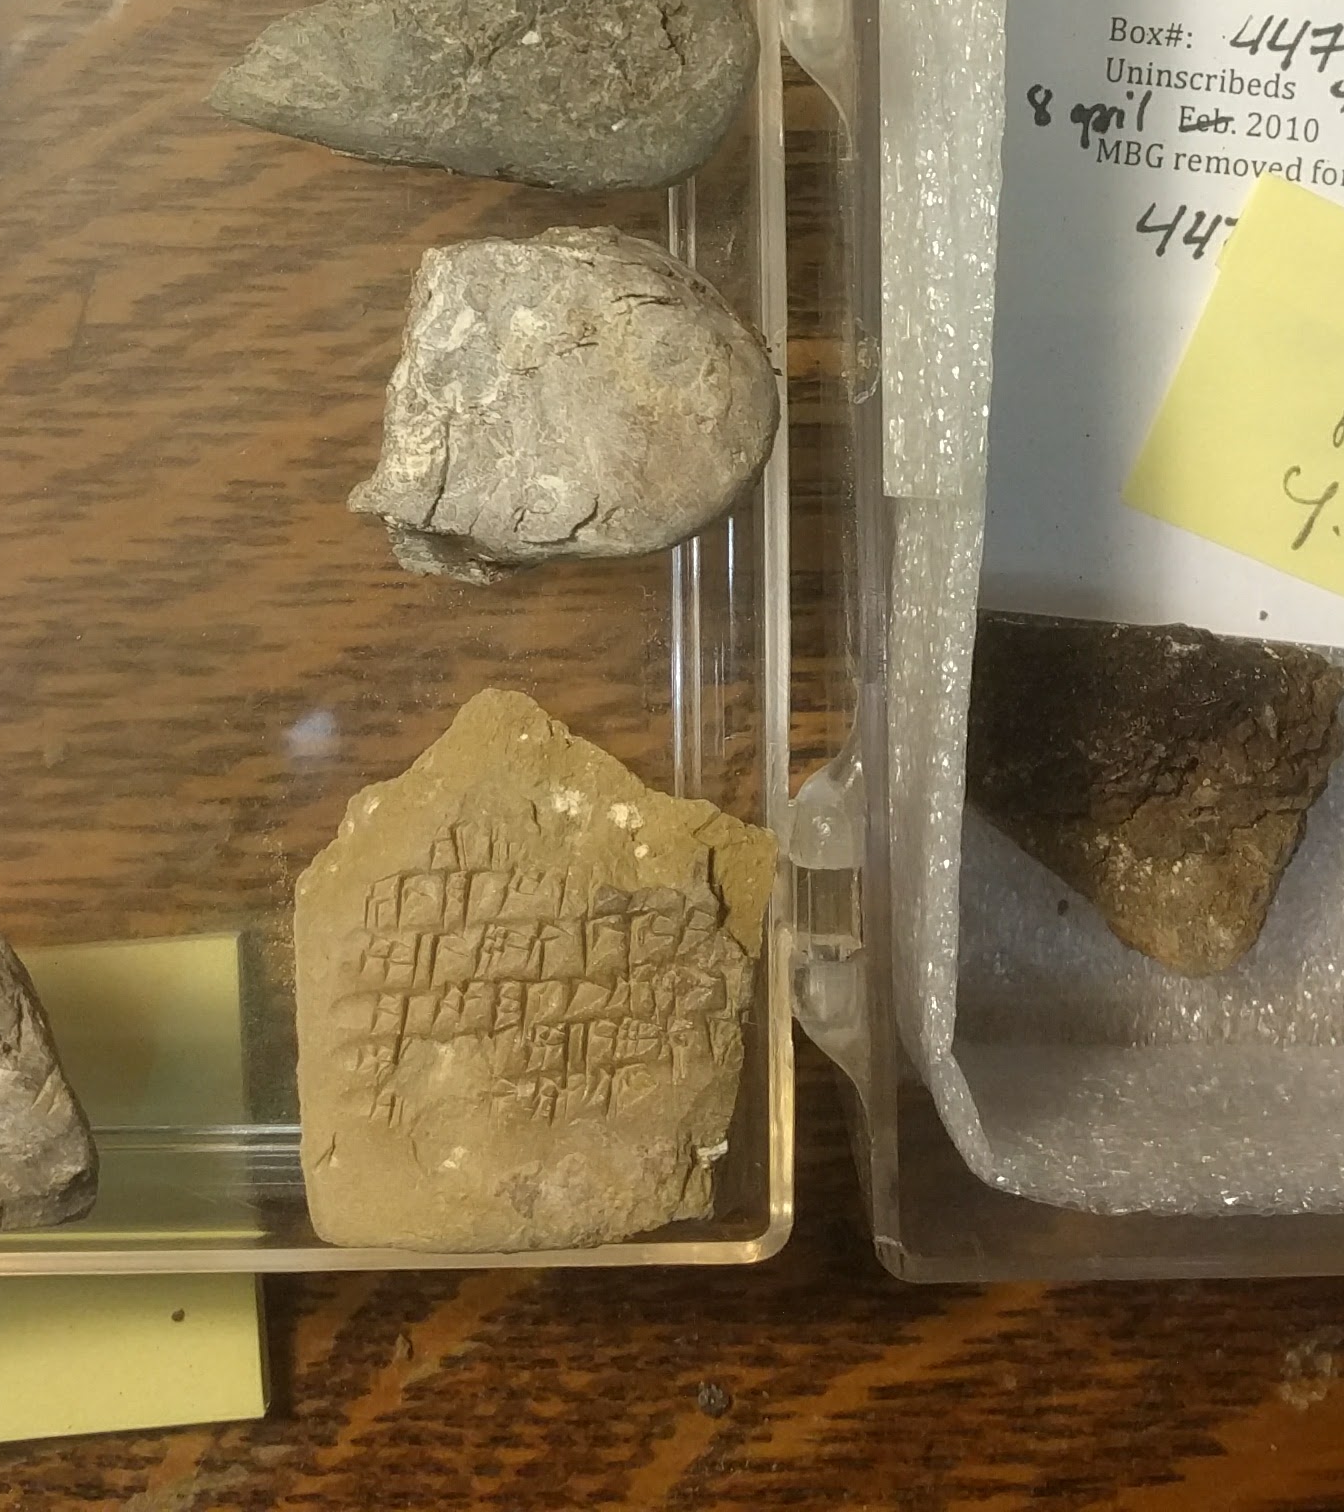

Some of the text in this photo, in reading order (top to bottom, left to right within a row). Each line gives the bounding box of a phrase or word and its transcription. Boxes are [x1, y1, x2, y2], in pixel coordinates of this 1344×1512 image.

[1109, 16, 1193, 50] Box#:
[1106, 57, 1296, 101] Uninscribeds
[1027, 84, 1053, 126] 8
[1246, 112, 1320, 143] 2010
[1096, 138, 1164, 169] MBG
[1173, 148, 1302, 182] removed
[1136, 202, 1240, 260] 44
